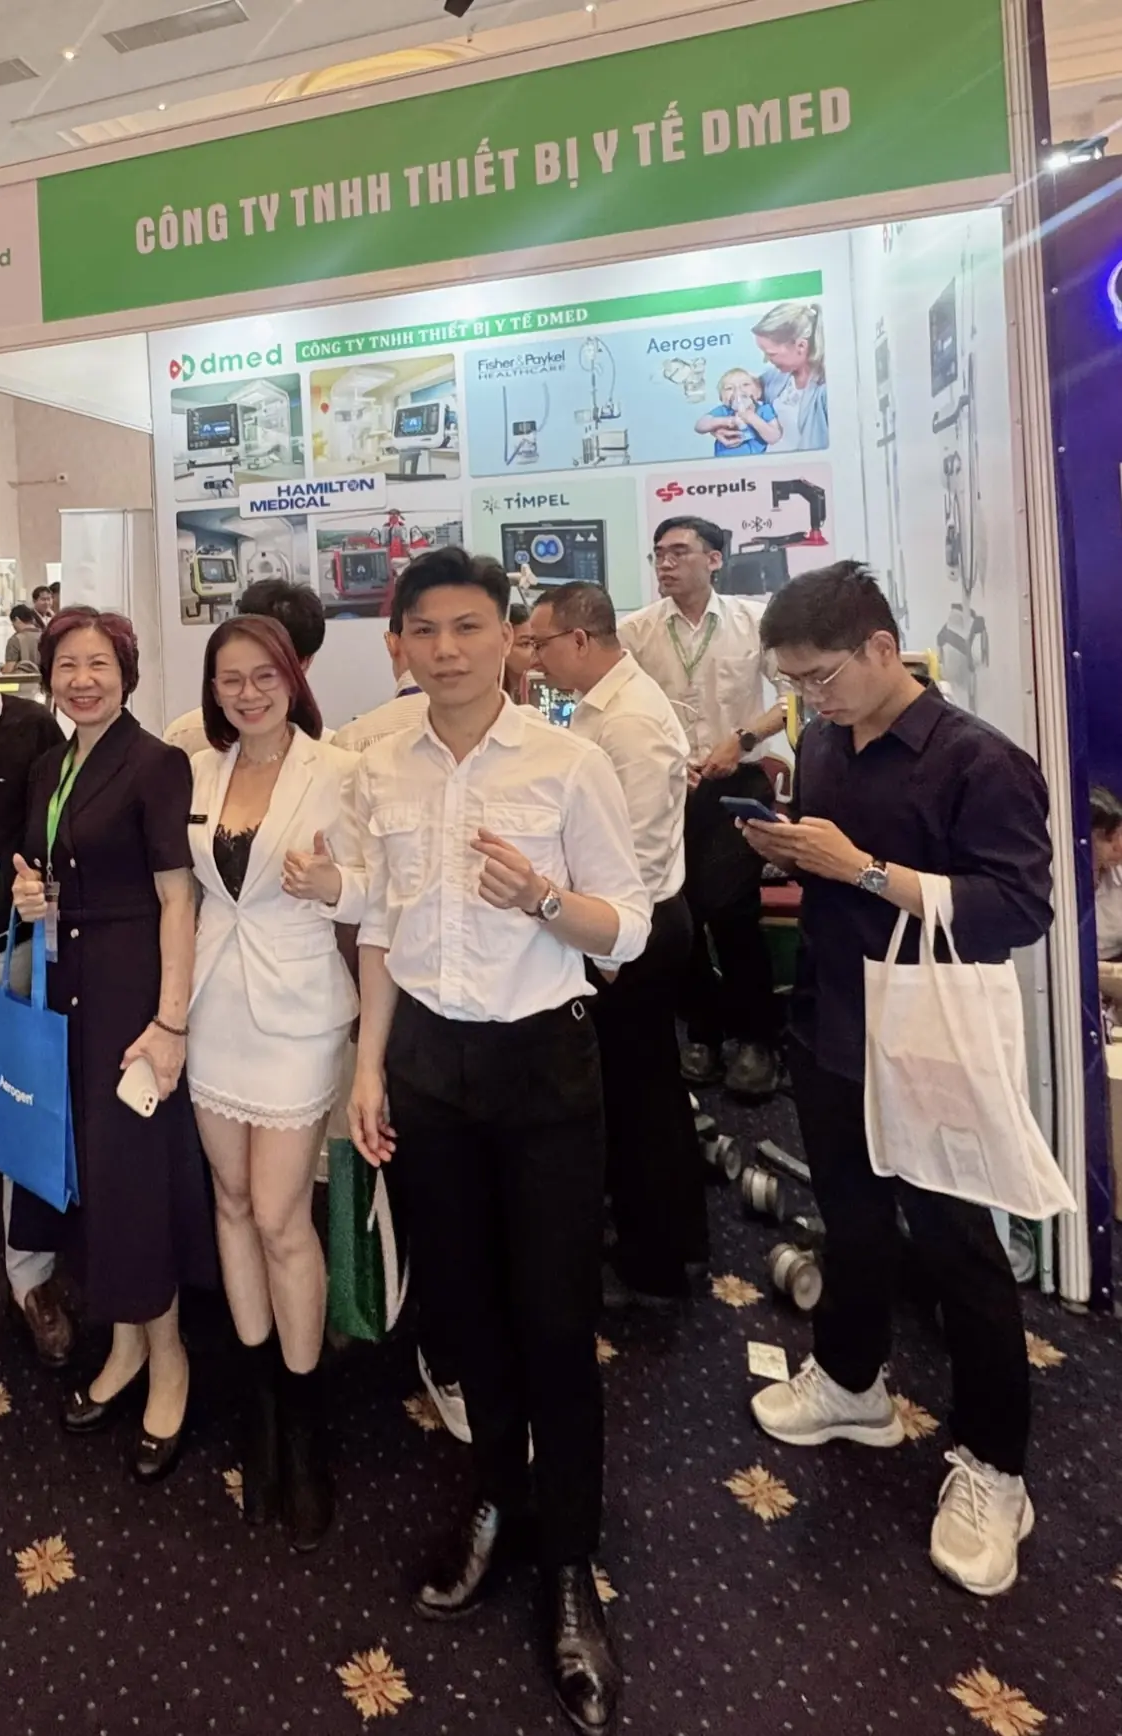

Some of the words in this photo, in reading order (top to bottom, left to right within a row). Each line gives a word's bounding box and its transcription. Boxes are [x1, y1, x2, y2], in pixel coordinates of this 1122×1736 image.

[135, 205, 228, 254] CÔNG
[239, 193, 279, 236] TY
[290, 172, 391, 227] TNHH
[403, 137, 519, 207] THIẾT
[534, 137, 578, 189] BỊ
[593, 129, 618, 174] Y
[632, 100, 686, 167] TẾ
[701, 86, 851, 156] DMED
[301, 341, 341, 359] CÔNG
[345, 338, 366, 352] TY
[369, 331, 414, 349] TNHH
[418, 320, 468, 343] THIẾT
[473, 320, 490, 336] BỊ
[495, 318, 506, 332] Y
[510, 311, 533, 330] TẾ
[537, 307, 589, 327] DMED
[646, 332, 732, 354] Aerogen
[200, 343, 282, 375] dmed
[478, 358, 515, 371] Fisher
[525, 349, 565, 367] Paykel
[479, 364, 565, 380] HEALTHCARE
[278, 478, 375, 498] HAMILTON
[687, 479, 756, 500] corpuls
[250, 495, 330, 512] MEDICAL
